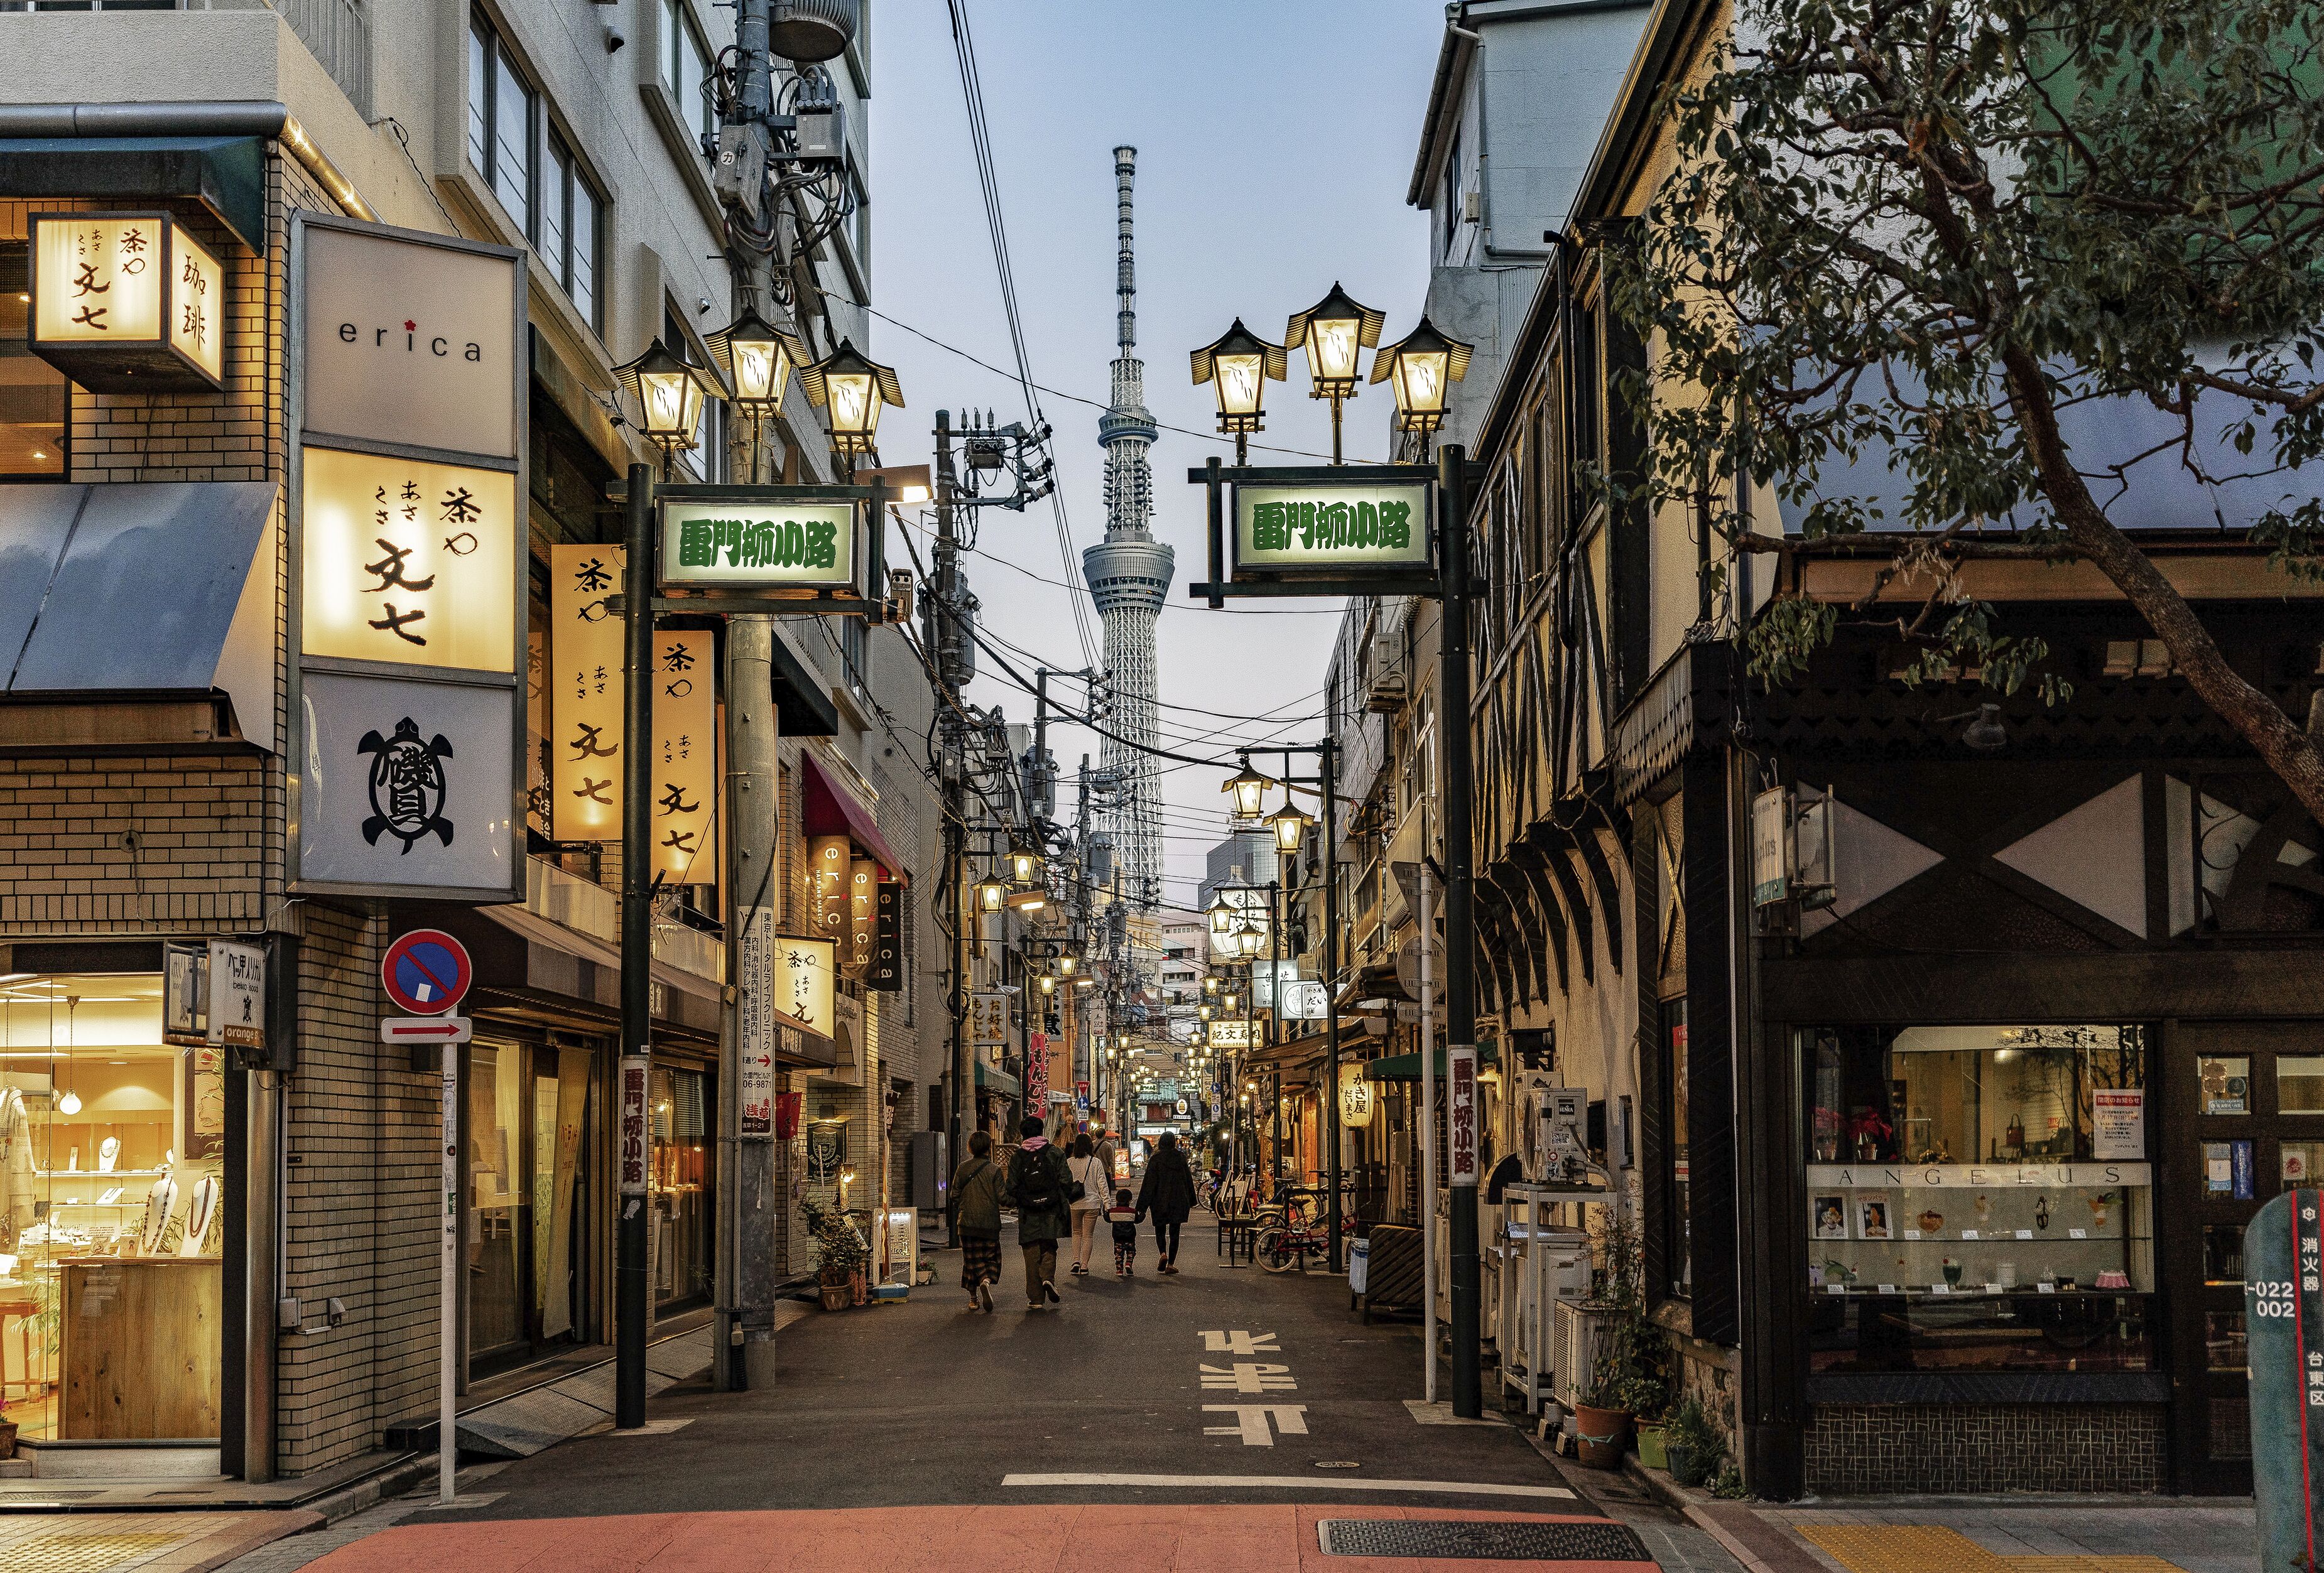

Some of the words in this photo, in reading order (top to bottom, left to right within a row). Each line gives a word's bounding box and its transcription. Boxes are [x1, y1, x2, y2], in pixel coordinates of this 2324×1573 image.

[71, 262, 111, 330] 文七
[182, 252, 206, 352] 珈琲
[339, 320, 481, 362] erica
[359, 538, 435, 647] 文七
[567, 723, 619, 806] 文七
[656, 783, 700, 855] 文七
[855, 873, 875, 965] erica
[880, 894, 898, 979] erica
[763, 912, 772, 1050] 東京トータルライフクリニック
[227, 1027, 254, 1042] orange
[742, 1056, 757, 1064] 通り
[742, 1080, 772, 1089] 06-9871
[746, 1103, 770, 1120] 浅草
[1345, 1090, 1353, 1120] だいまさ
[1353, 1073, 1367, 1115] かき屋
[1839, 1166, 2120, 1185] ANGELUS
[2301, 1237, 2319, 1292] 消火器
[2257, 1300, 2295, 1318] 002
[2308, 1351, 2324, 1406] 台東区
